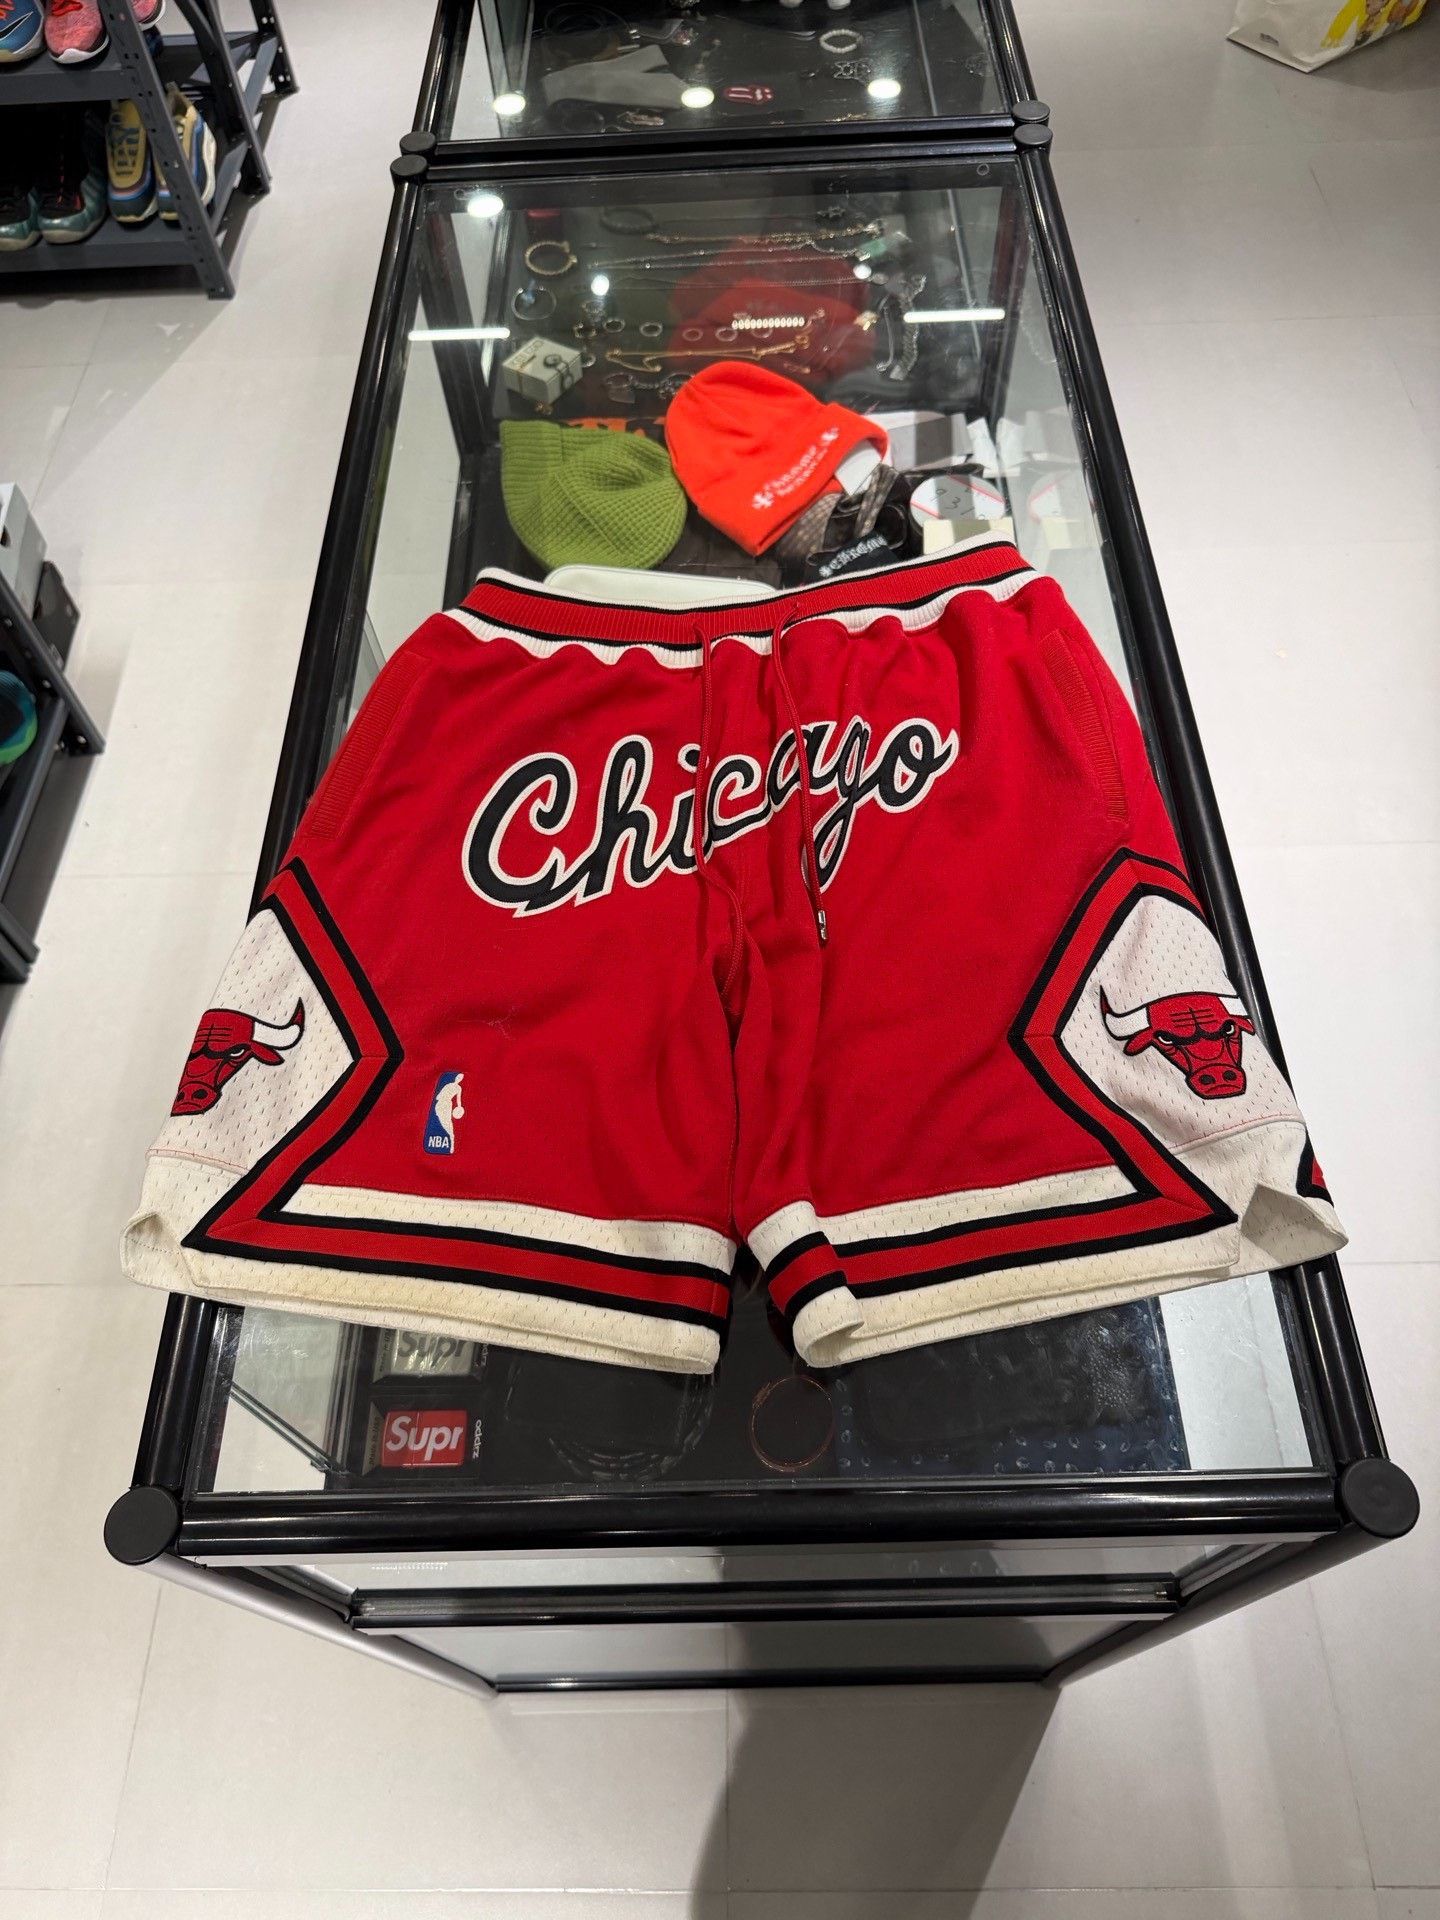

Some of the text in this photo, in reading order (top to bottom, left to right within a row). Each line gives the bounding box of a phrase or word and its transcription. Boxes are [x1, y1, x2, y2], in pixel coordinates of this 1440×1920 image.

[461, 715, 959, 918] Chicago
[428, 1135, 450, 1149] NBA
[385, 1415, 464, 1462] Supr
